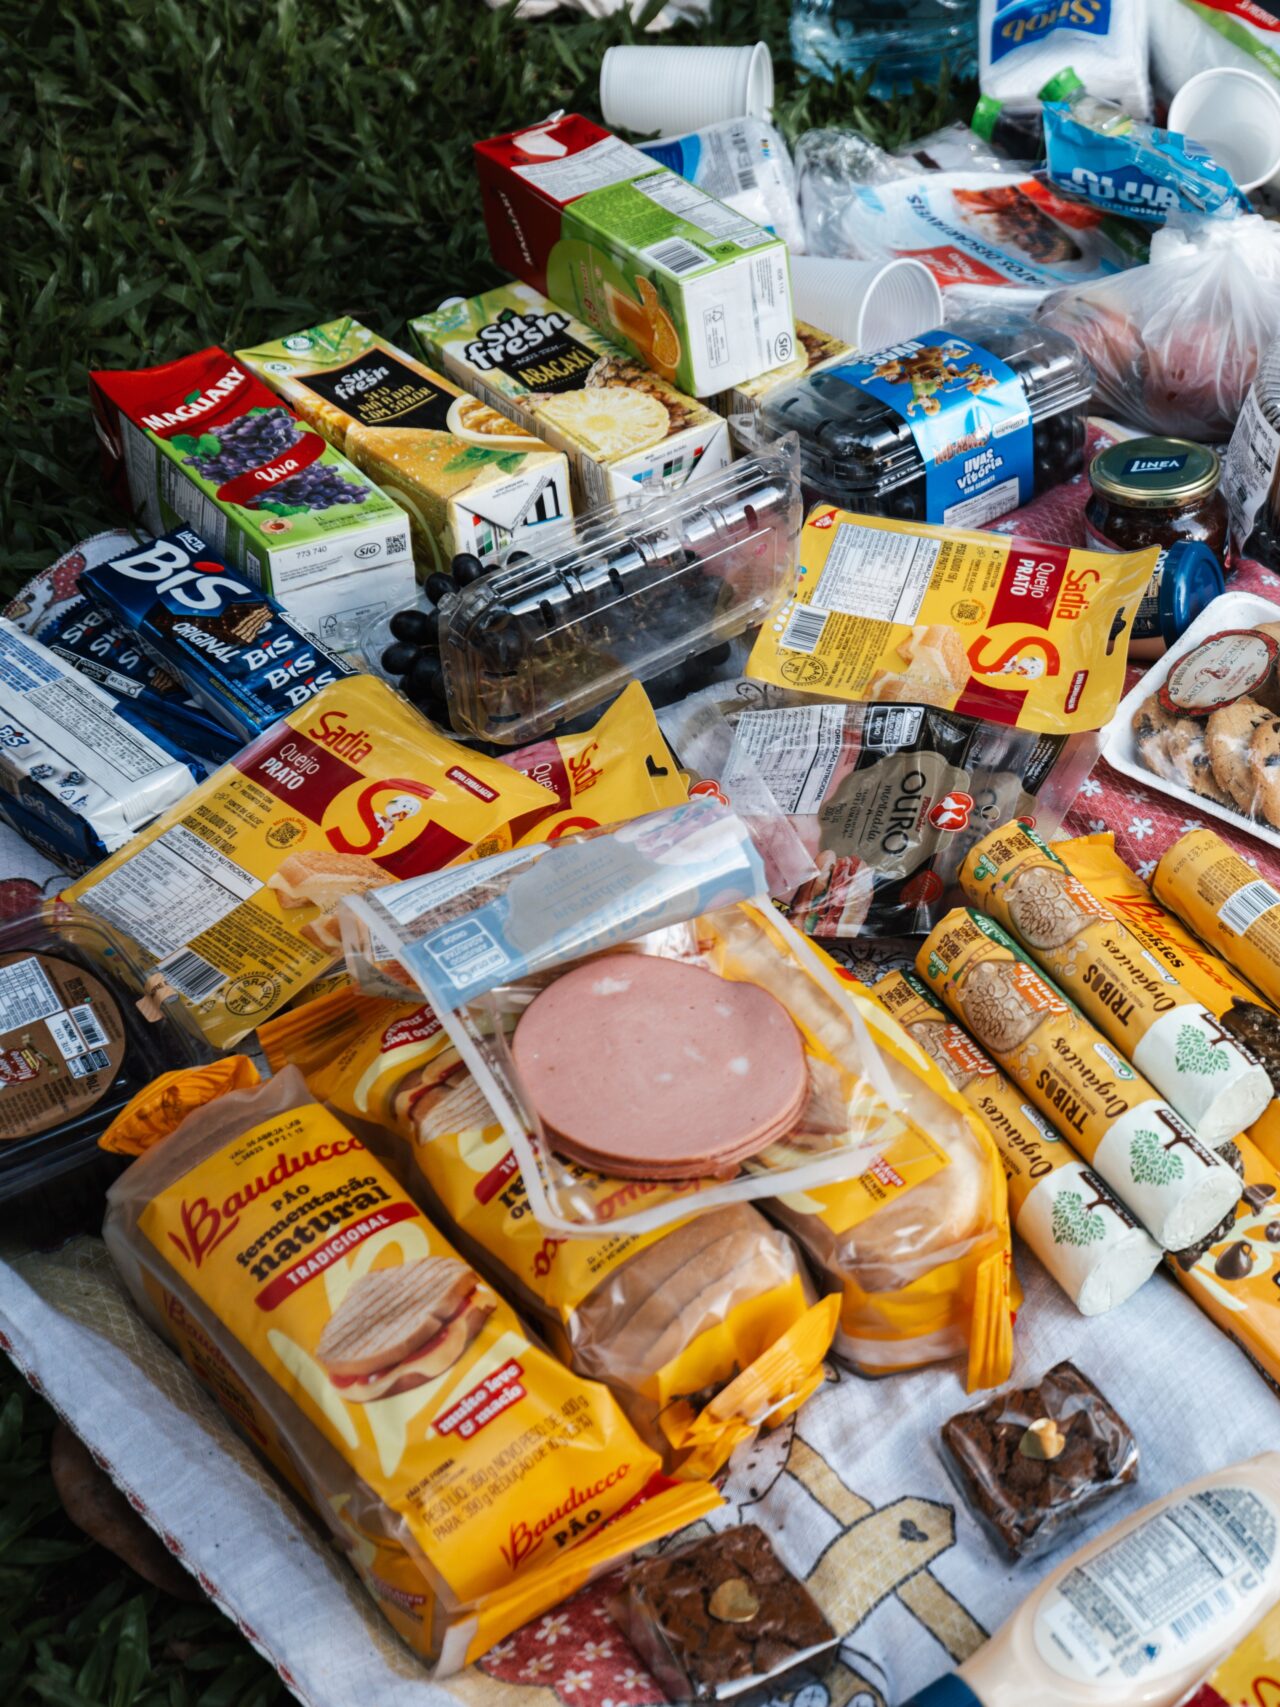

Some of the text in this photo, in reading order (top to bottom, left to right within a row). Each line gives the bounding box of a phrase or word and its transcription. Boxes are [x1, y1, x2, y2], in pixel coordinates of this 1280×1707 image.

[467, 314, 566, 370] fresh
[140, 366, 247, 432] MAGUARY
[334, 366, 390, 400] fresh
[253, 456, 300, 485] Uva
[1130, 459, 1180, 473] LINEA
[176, 530, 206, 553] LACTA
[358, 544, 377, 557] SIG
[1010, 558, 1036, 597] PRATO
[1030, 562, 1057, 599] Queijo
[1056, 568, 1101, 621] Sadia
[171, 622, 242, 664] ORIGINAL
[279, 743, 321, 775] Queijo
[308, 711, 373, 765] Sadia
[259, 757, 306, 791] PRATO
[881, 769, 927, 856] OURO
[178, 829, 256, 885] INFORMAÇÃO NUTRICIONAL
[939, 934, 963, 959] FIBRAS
[1082, 963, 1136, 1028] TRIBOS
[1101, 937, 1177, 1013] Orgânicos
[1035, 1069, 1090, 1136] TRIBOS
[1051, 1036, 1129, 1120] Orgânicos
[978, 1096, 1053, 1179] Orgânicos
[167, 1136, 368, 1270] Bauducco
[235, 1175, 378, 1268] fermentação
[270, 1183, 311, 1212] PÃO
[249, 1185, 393, 1286] natural
[286, 1213, 392, 1285] TRADICIONAL
[438, 1363, 521, 1434] muito leve
[474, 1383, 524, 1425] macio
[488, 1456, 535, 1500] REDUÇÃO
[492, 1446, 520, 1473] NOVO
[499, 1462, 631, 1572] Bauducco
[552, 1509, 602, 1548] PÃO
